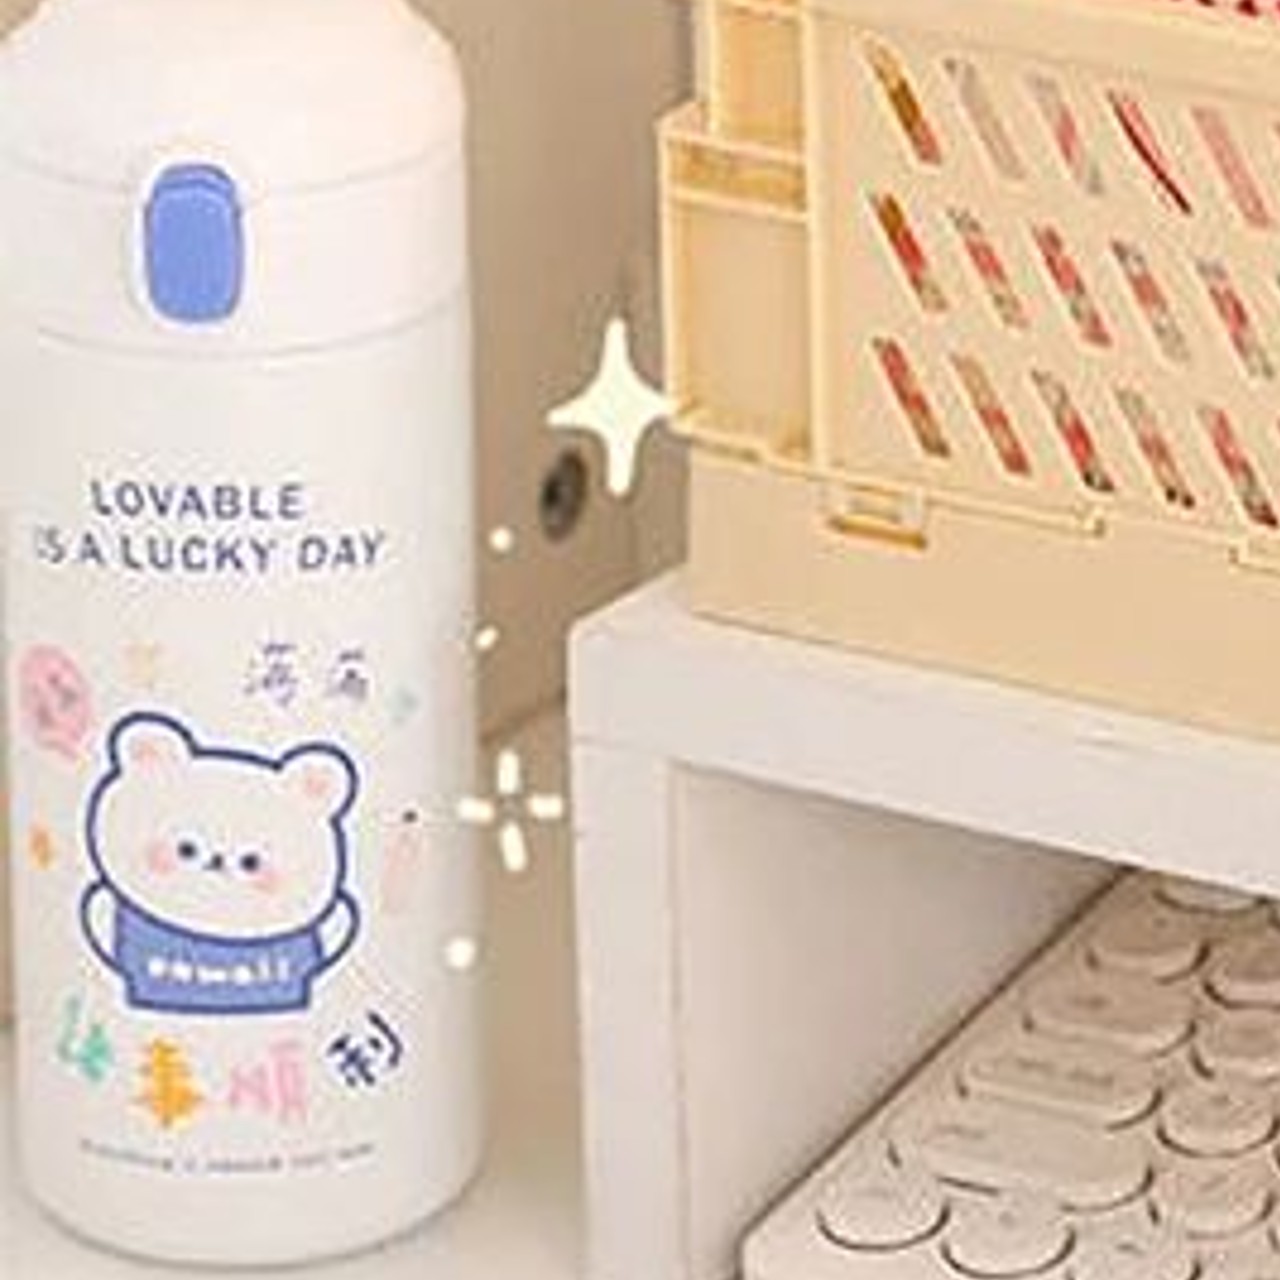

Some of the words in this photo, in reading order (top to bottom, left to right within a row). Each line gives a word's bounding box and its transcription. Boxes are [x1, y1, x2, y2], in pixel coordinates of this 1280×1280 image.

[91, 478, 306, 521] LOVABLE
[78, 531, 105, 567] A
[118, 534, 278, 575] LUCKY
[297, 531, 386, 569] DAY
